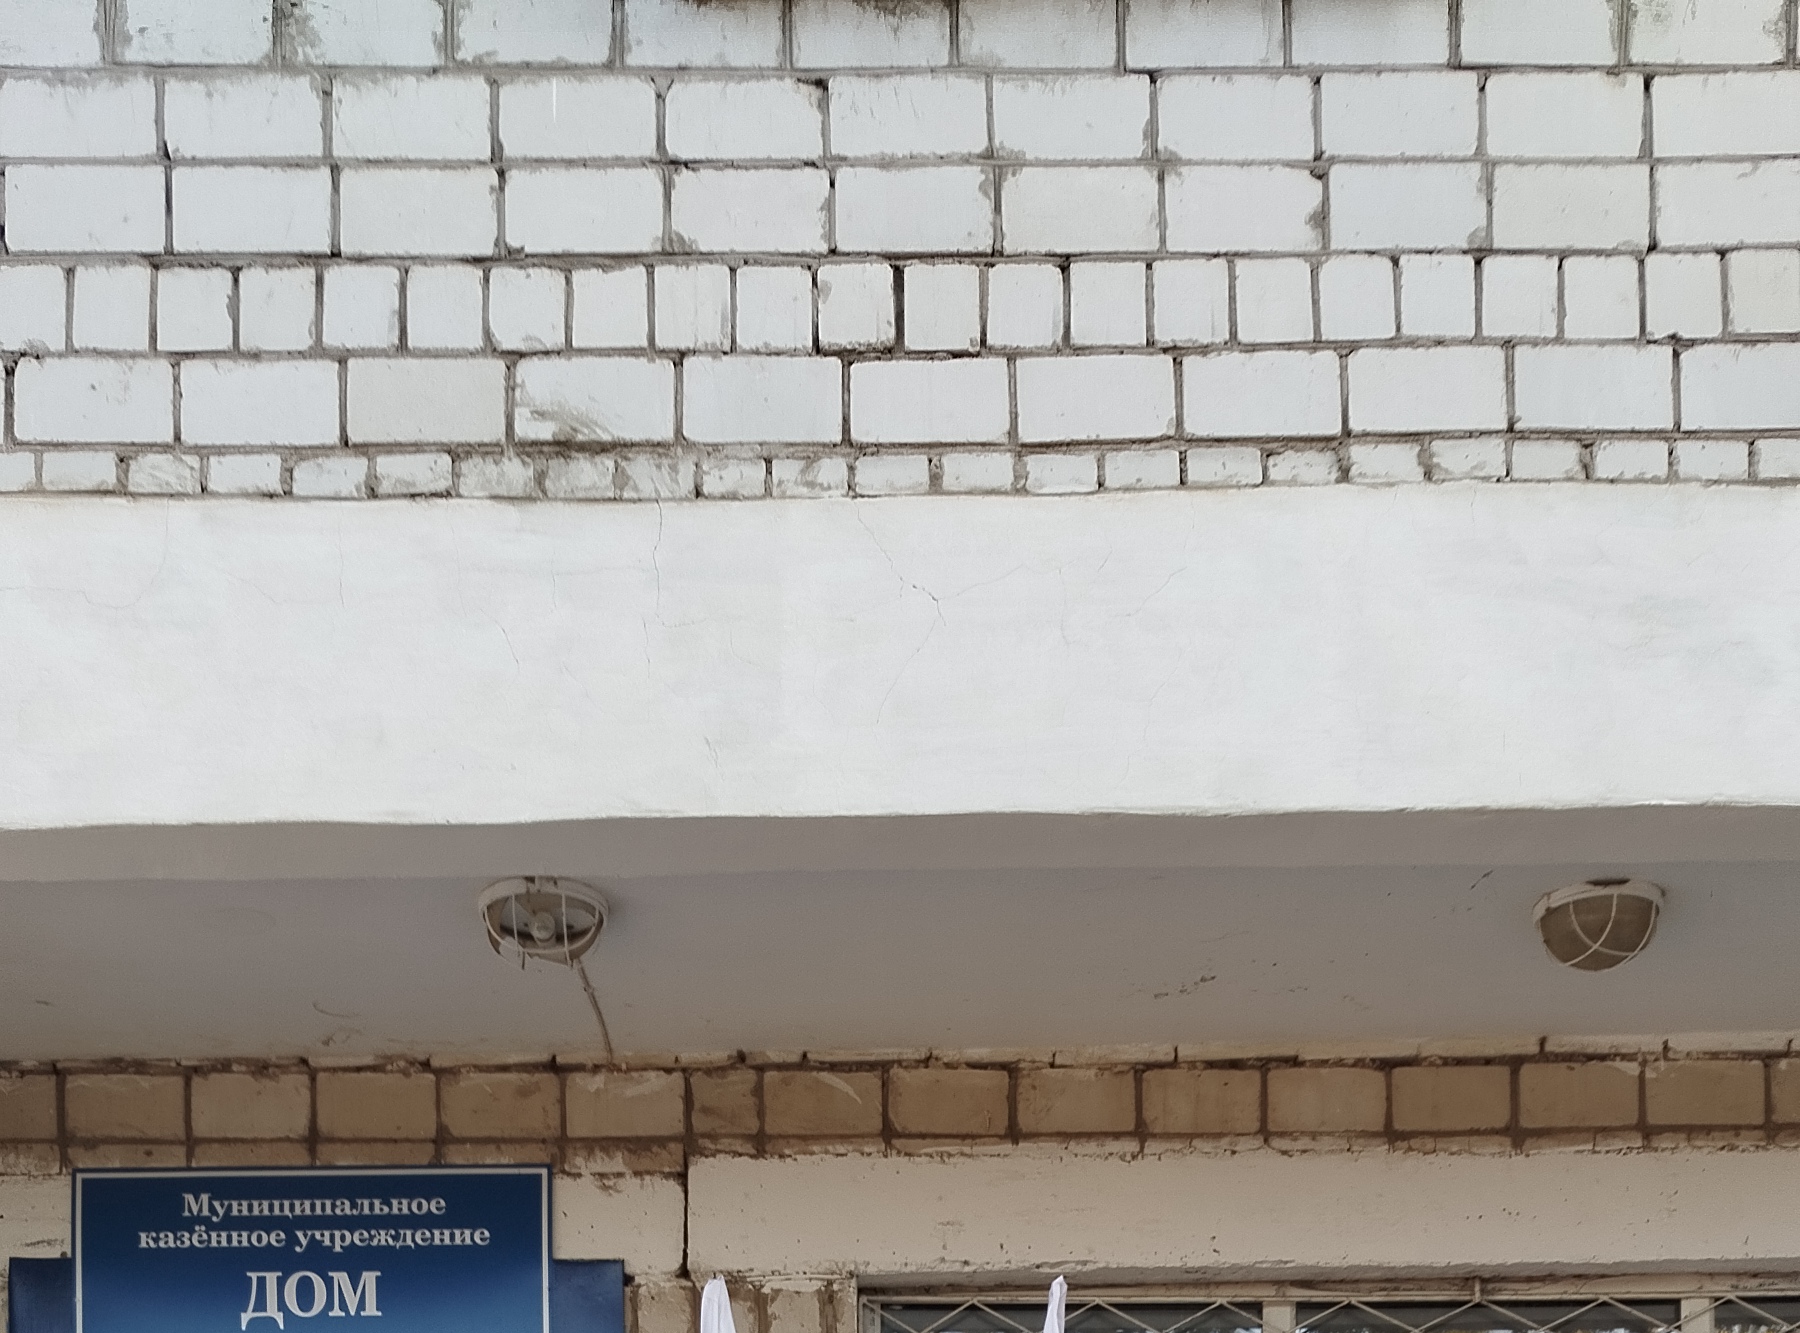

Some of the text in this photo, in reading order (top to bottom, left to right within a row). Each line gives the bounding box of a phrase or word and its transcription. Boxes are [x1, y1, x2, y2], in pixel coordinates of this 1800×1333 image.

[182, 1193, 446, 1222] Муниципальное
[138, 1225, 490, 1252] казённое учреждение
[241, 1271, 382, 1330] ДОМ
